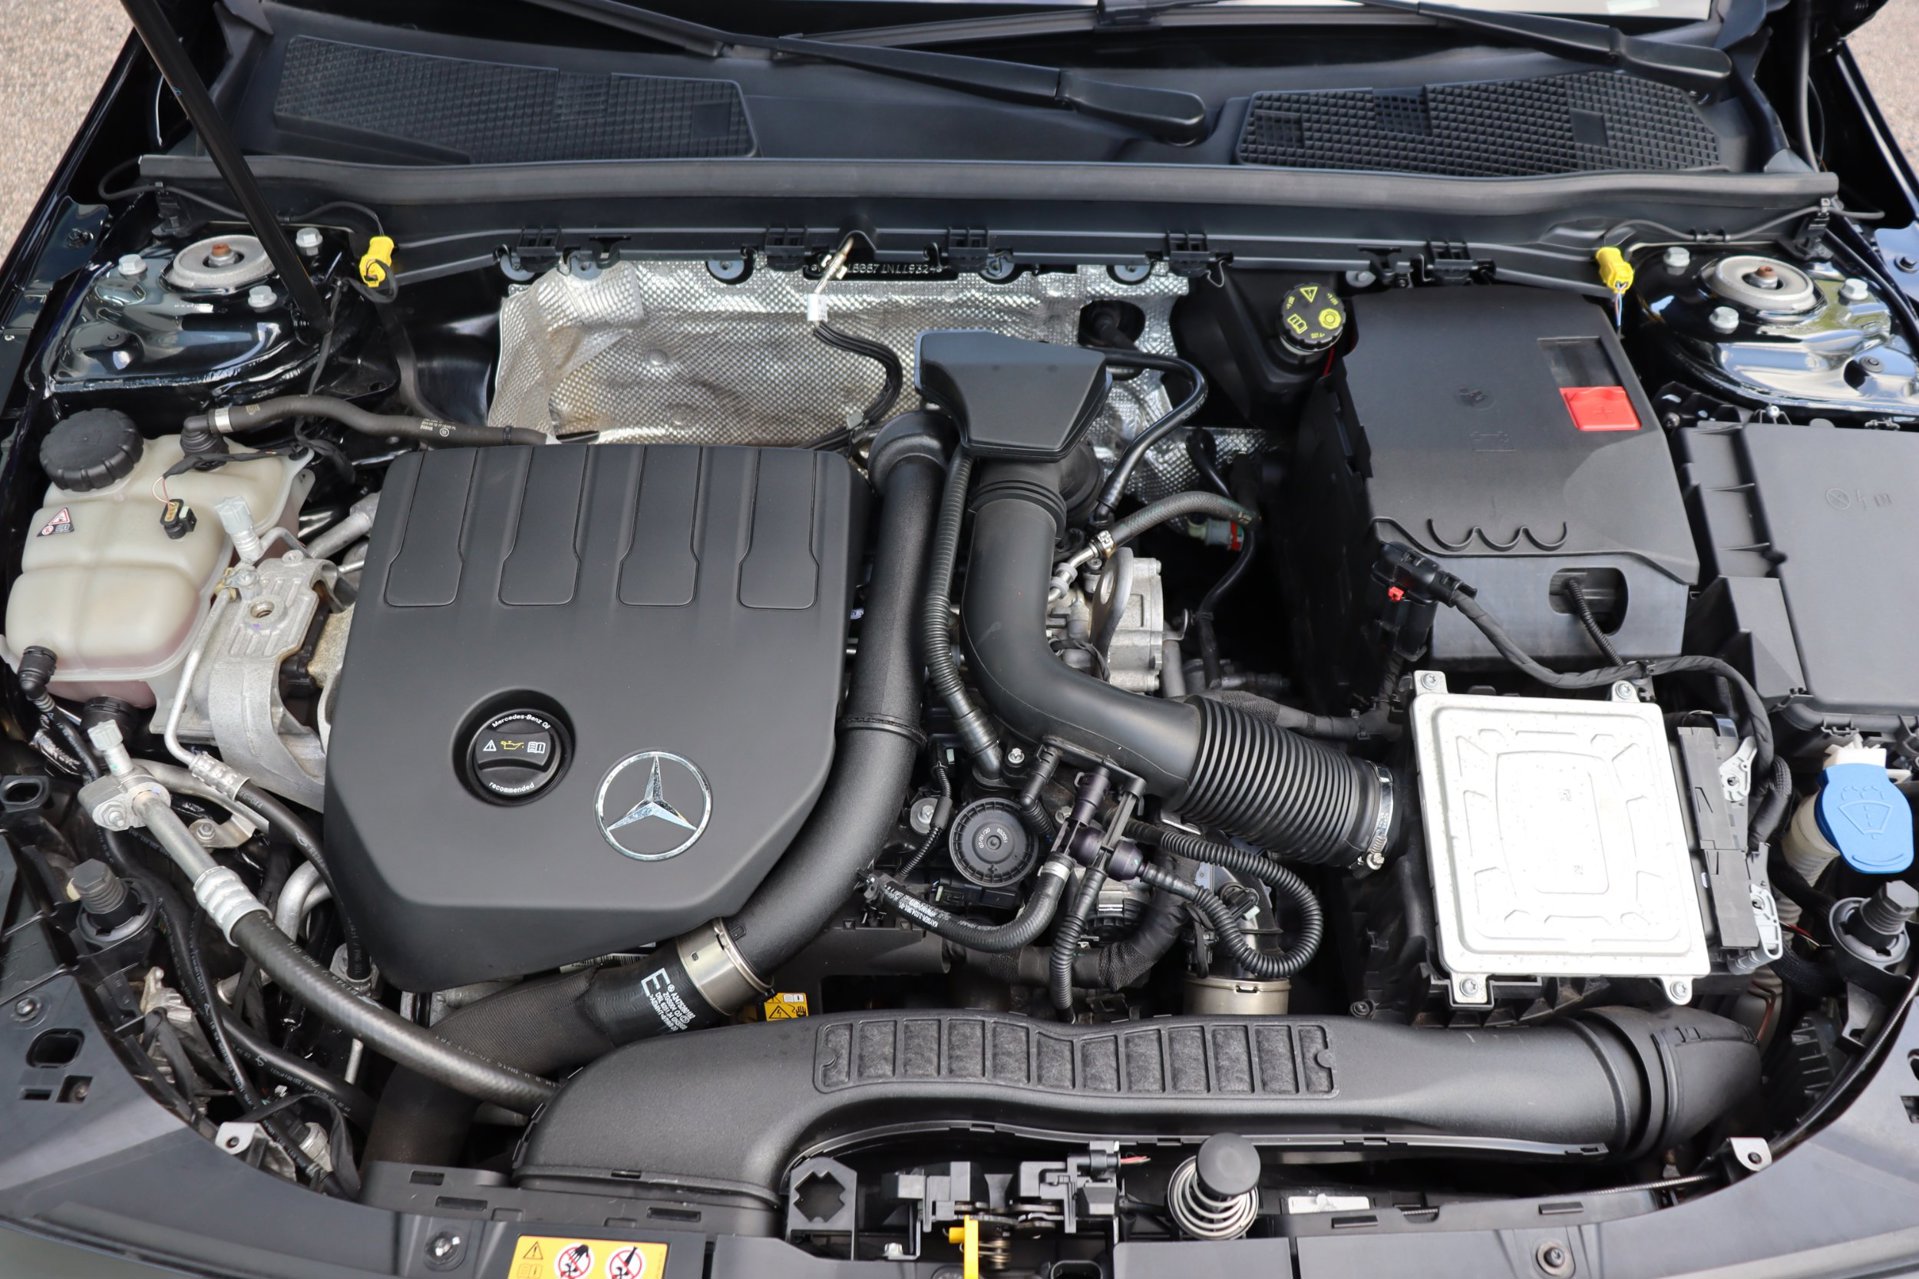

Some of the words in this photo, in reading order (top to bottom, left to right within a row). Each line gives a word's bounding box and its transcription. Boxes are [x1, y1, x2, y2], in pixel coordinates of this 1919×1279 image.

[492, 713, 543, 729] Mercedes-Benz
[488, 781, 535, 794] recommended
[640, 967, 671, 997] E
